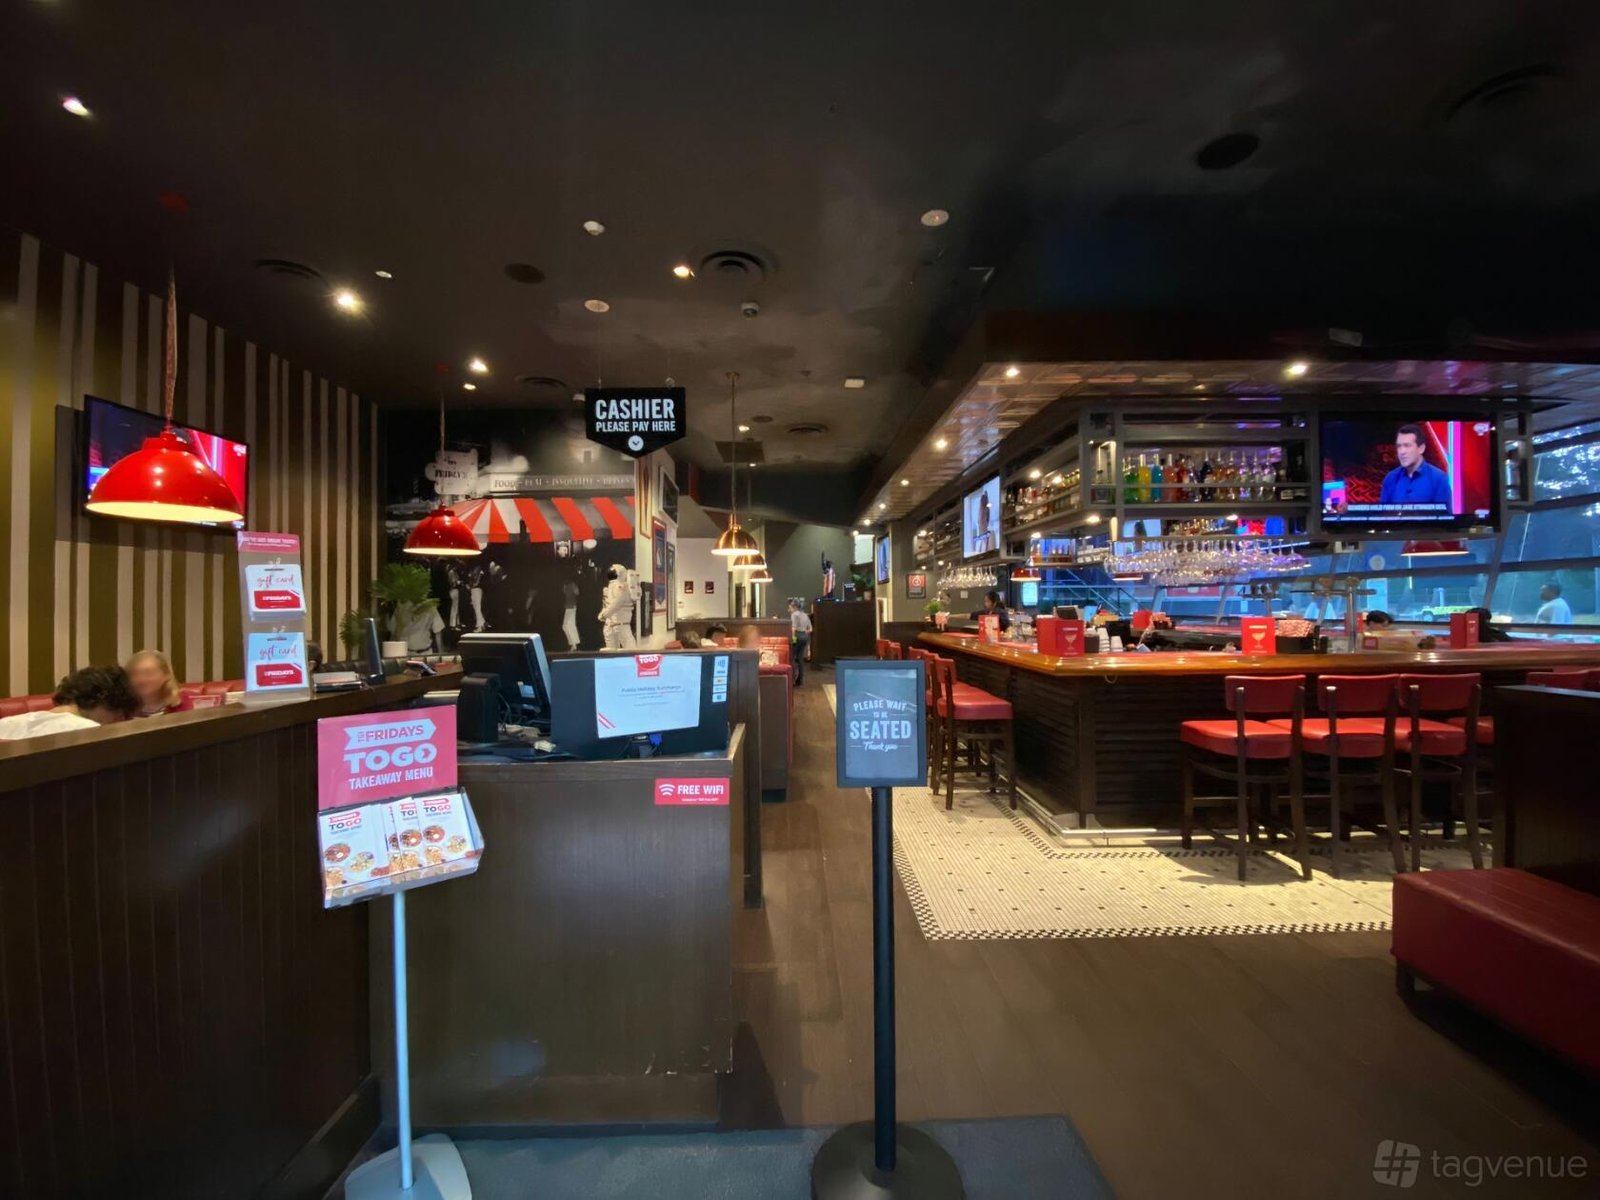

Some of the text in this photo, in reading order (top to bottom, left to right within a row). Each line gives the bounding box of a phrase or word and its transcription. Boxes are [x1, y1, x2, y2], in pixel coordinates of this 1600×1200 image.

[595, 399, 675, 419] CASHIER
[596, 421, 676, 432] PLEASE PAY HERE
[853, 700, 907, 712] PLEASE WAIT
[365, 725, 424, 743] FRIDAYS
[850, 720, 911, 739] SEATED
[343, 743, 437, 774] TOGO
[349, 767, 433, 790] TAKEAWAY MENU
[677, 784, 724, 795] FREE WIFI
